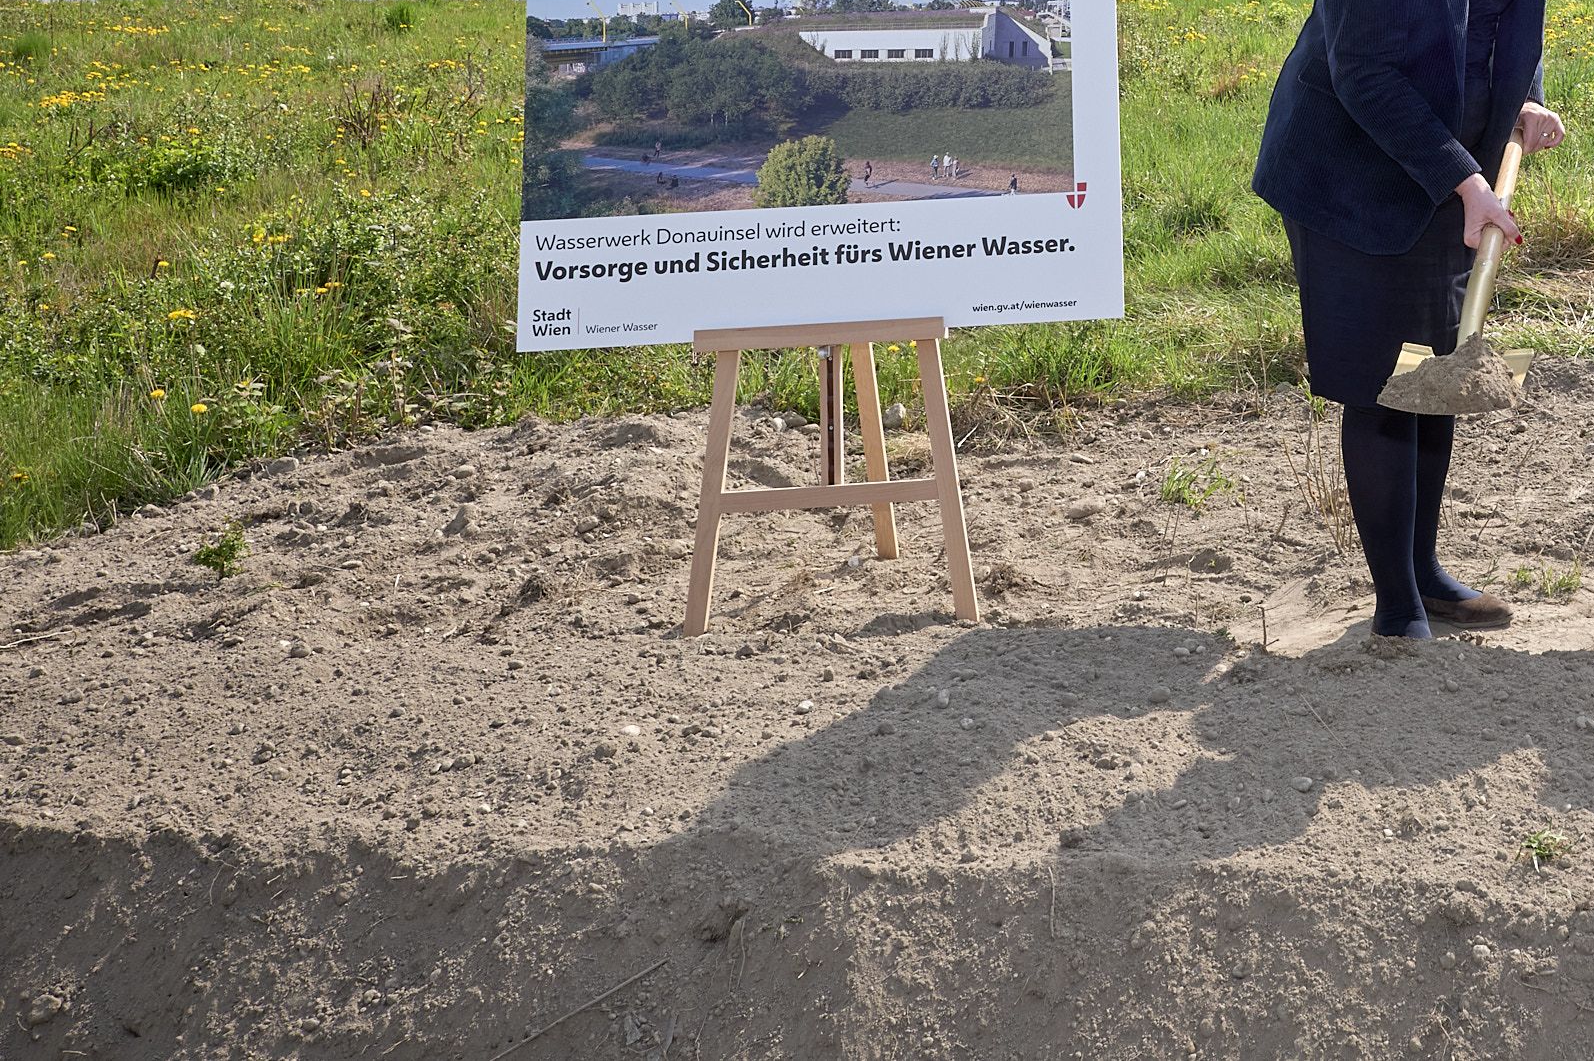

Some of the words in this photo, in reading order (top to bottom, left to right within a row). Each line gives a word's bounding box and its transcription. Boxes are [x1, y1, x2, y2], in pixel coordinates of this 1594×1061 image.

[535, 229, 651, 251] Wasserwerk
[656, 223, 760, 245] Donauinsel
[765, 220, 806, 238] wird
[811, 218, 901, 237] erweitert:
[535, 261, 648, 283] Vorsorge
[654, 252, 700, 275] und
[706, 246, 829, 272] Sicherheit
[835, 244, 882, 265] fürs
[888, 240, 976, 262] Wiener
[982, 236, 1076, 256] Wasser.
[972, 300, 1078, 313] wien.gv.at/wienwasser
[532, 308, 572, 322] Stadt
[532, 323, 571, 337] Wien
[585, 324, 621, 334] Wiener
[622, 322, 658, 332] Wasser
